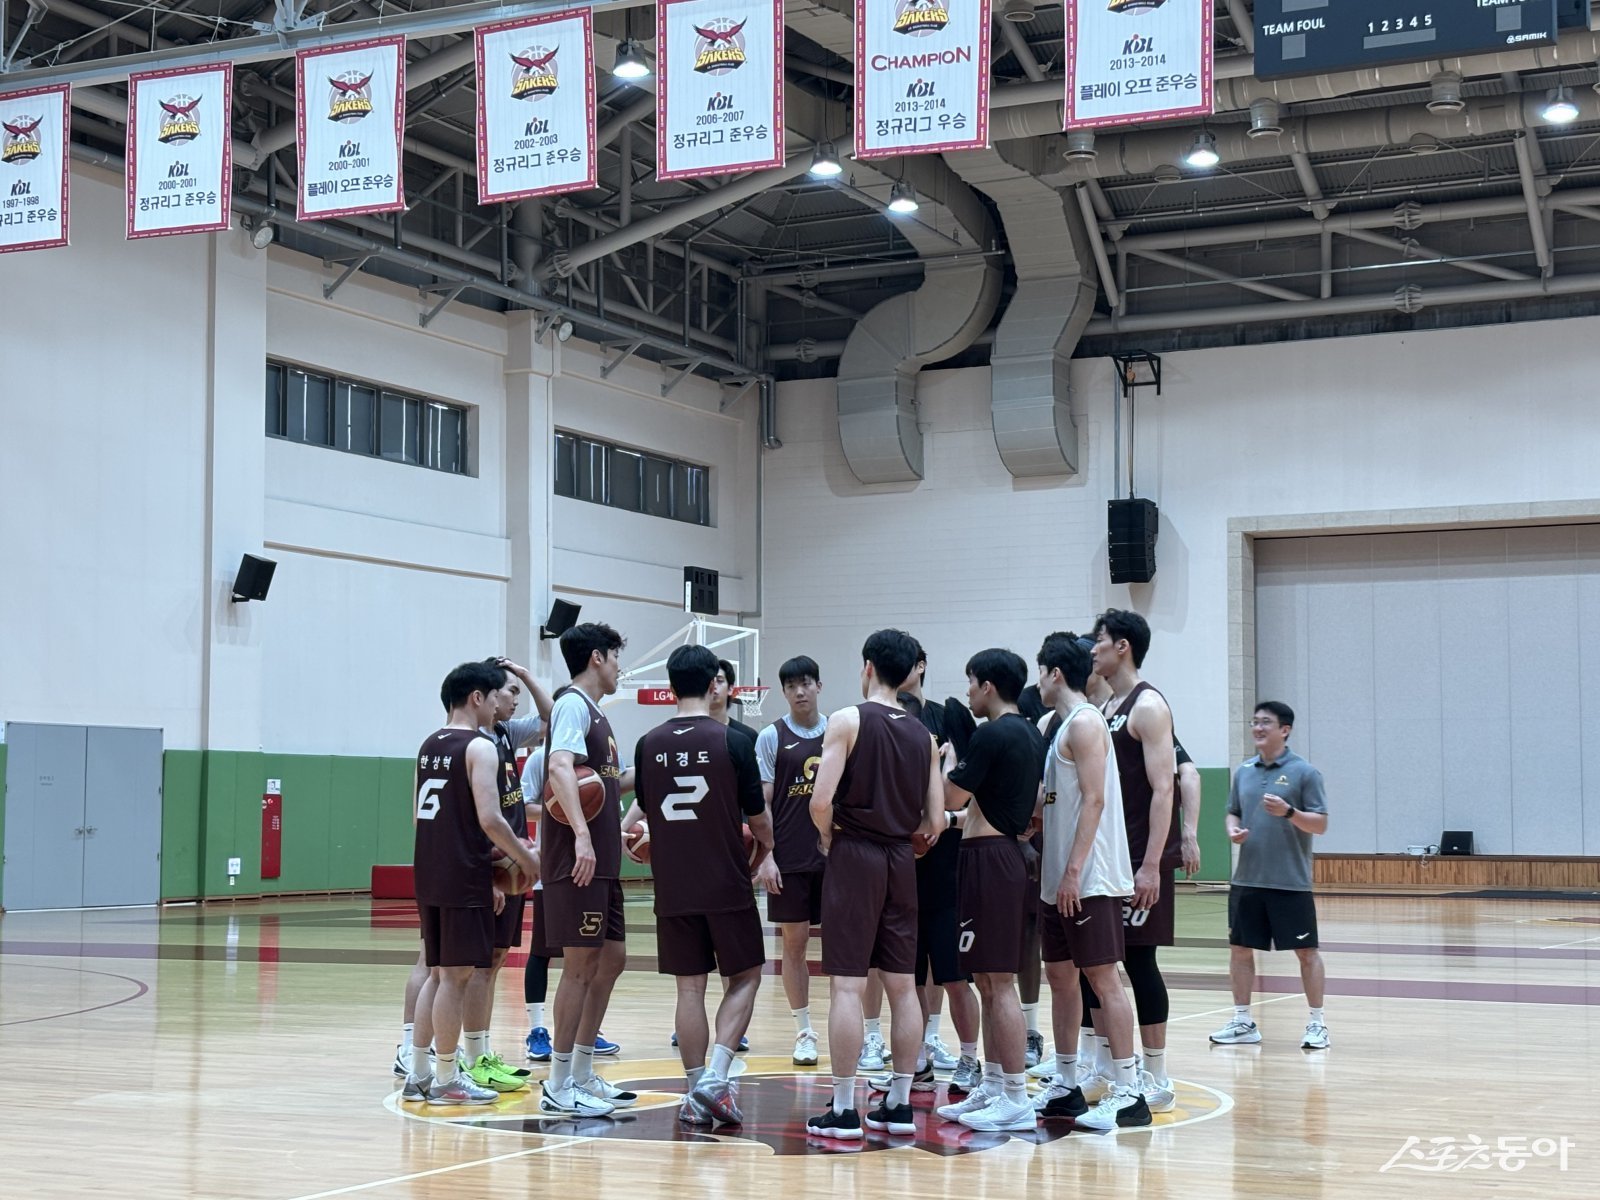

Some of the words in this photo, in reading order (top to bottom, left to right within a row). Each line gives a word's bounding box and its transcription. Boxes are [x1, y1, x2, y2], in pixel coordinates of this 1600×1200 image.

[896, 8, 948, 28] SAKERS
[1262, 22, 1294, 36] TEAM
[1297, 17, 1326, 32] FOUL
[1368, 22, 1374, 33] 1
[1381, 20, 1389, 32] 2
[1395, 18, 1403, 30] 3
[1410, 16, 1418, 28] 4
[1424, 14, 1432, 26] 5
[1122, 34, 1154, 55] KBL
[1514, 31, 1547, 42] SAMIK
[695, 47, 746, 68] SAKERS
[871, 45, 971, 71] CHAMPION
[1110, 54, 1166, 71] 2013-2014
[514, 75, 558, 94] SAKERS
[906, 78, 935, 98] KBL
[1080, 81, 1121, 101] 플레이
[1124, 78, 1152, 95] 오프
[1156, 73, 1198, 92] 준우승
[331, 99, 372, 116] SAKERS
[707, 92, 734, 111] KBL
[895, 98, 946, 113] 2013-2014
[524, 117, 549, 136] KBL
[696, 110, 744, 126] 2006-2007
[876, 116, 932, 136] 정규리그
[937, 112, 967, 130] 우승
[160, 122, 199, 139] SAKERS
[673, 129, 724, 149] 정규리그
[730, 124, 768, 142] 준우승
[339, 140, 360, 158] KBL
[514, 134, 558, 150] 2002-2003
[168, 160, 189, 178] KBL
[328, 157, 370, 171] 2000-2001
[493, 153, 541, 174] 정규리그
[546, 147, 582, 166] 준우승
[11, 179, 31, 196] KBL
[158, 178, 197, 190] 2000-2001
[307, 180, 338, 197] 플레이
[340, 177, 361, 193] 오프
[362, 173, 394, 191] 준우승
[139, 194, 181, 211] 정규리그
[185, 191, 216, 206] 준우승
[27, 208, 57, 223] 준우승
[416, 778, 449, 820] 6
[660, 775, 710, 822] 2
